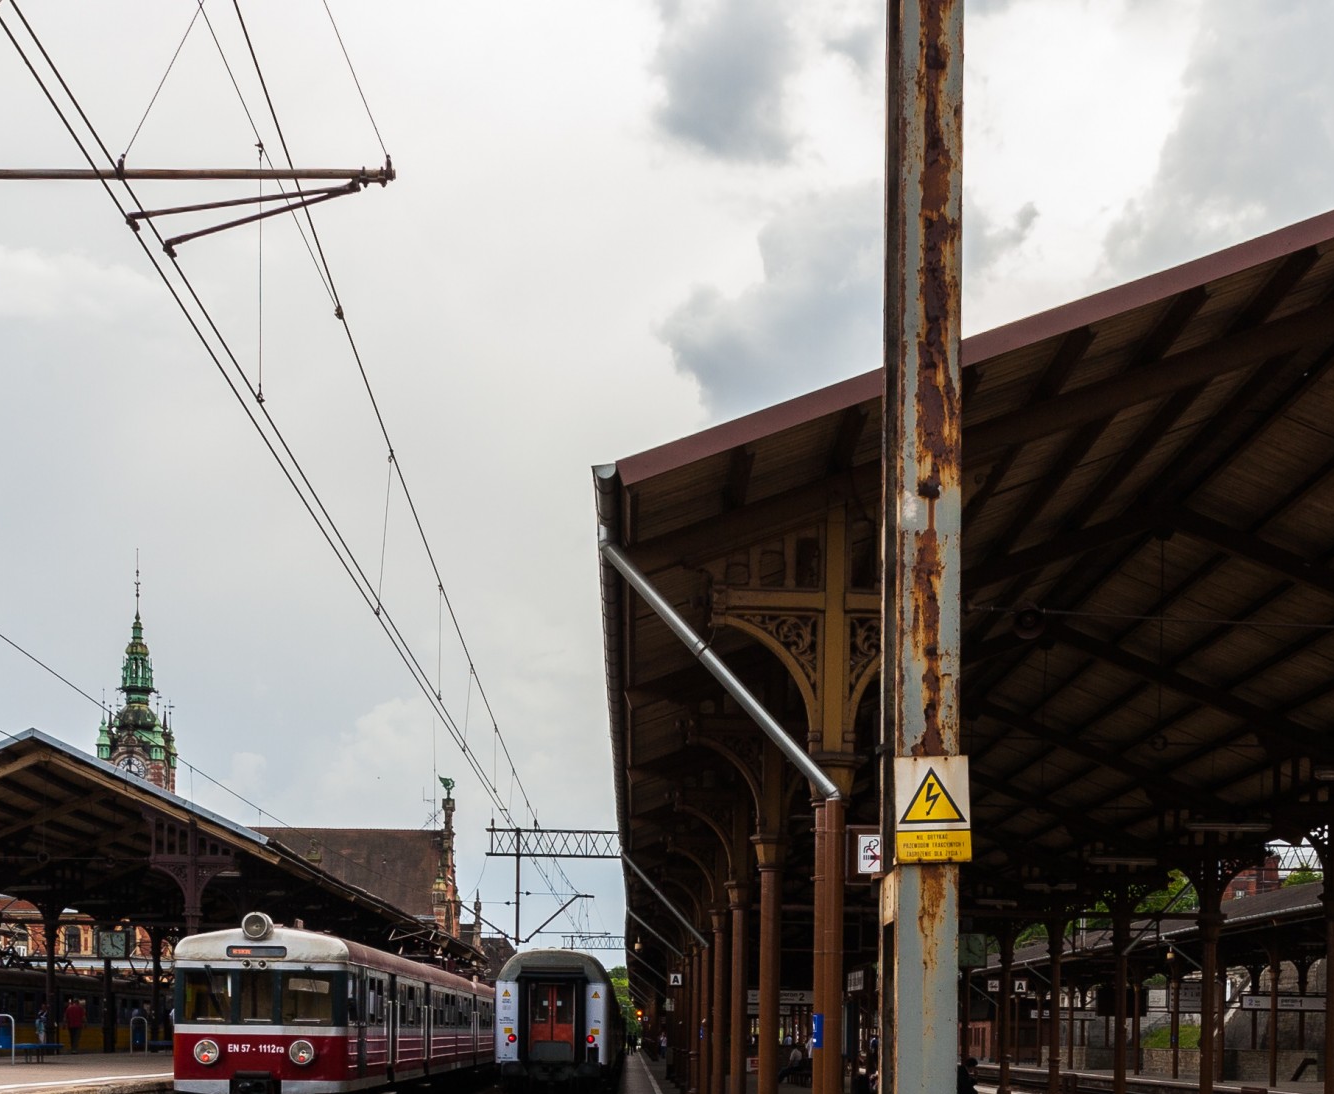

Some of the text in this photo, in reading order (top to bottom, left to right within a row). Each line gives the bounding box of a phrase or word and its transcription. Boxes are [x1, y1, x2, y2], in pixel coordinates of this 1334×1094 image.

[672, 975, 680, 984] A
[1016, 982, 1024, 990] A
[799, 992, 804, 1001] 2
[228, 1044, 239, 1052] EN
[241, 1044, 250, 1052] 57
[258, 1044, 284, 1054] 1112ra
